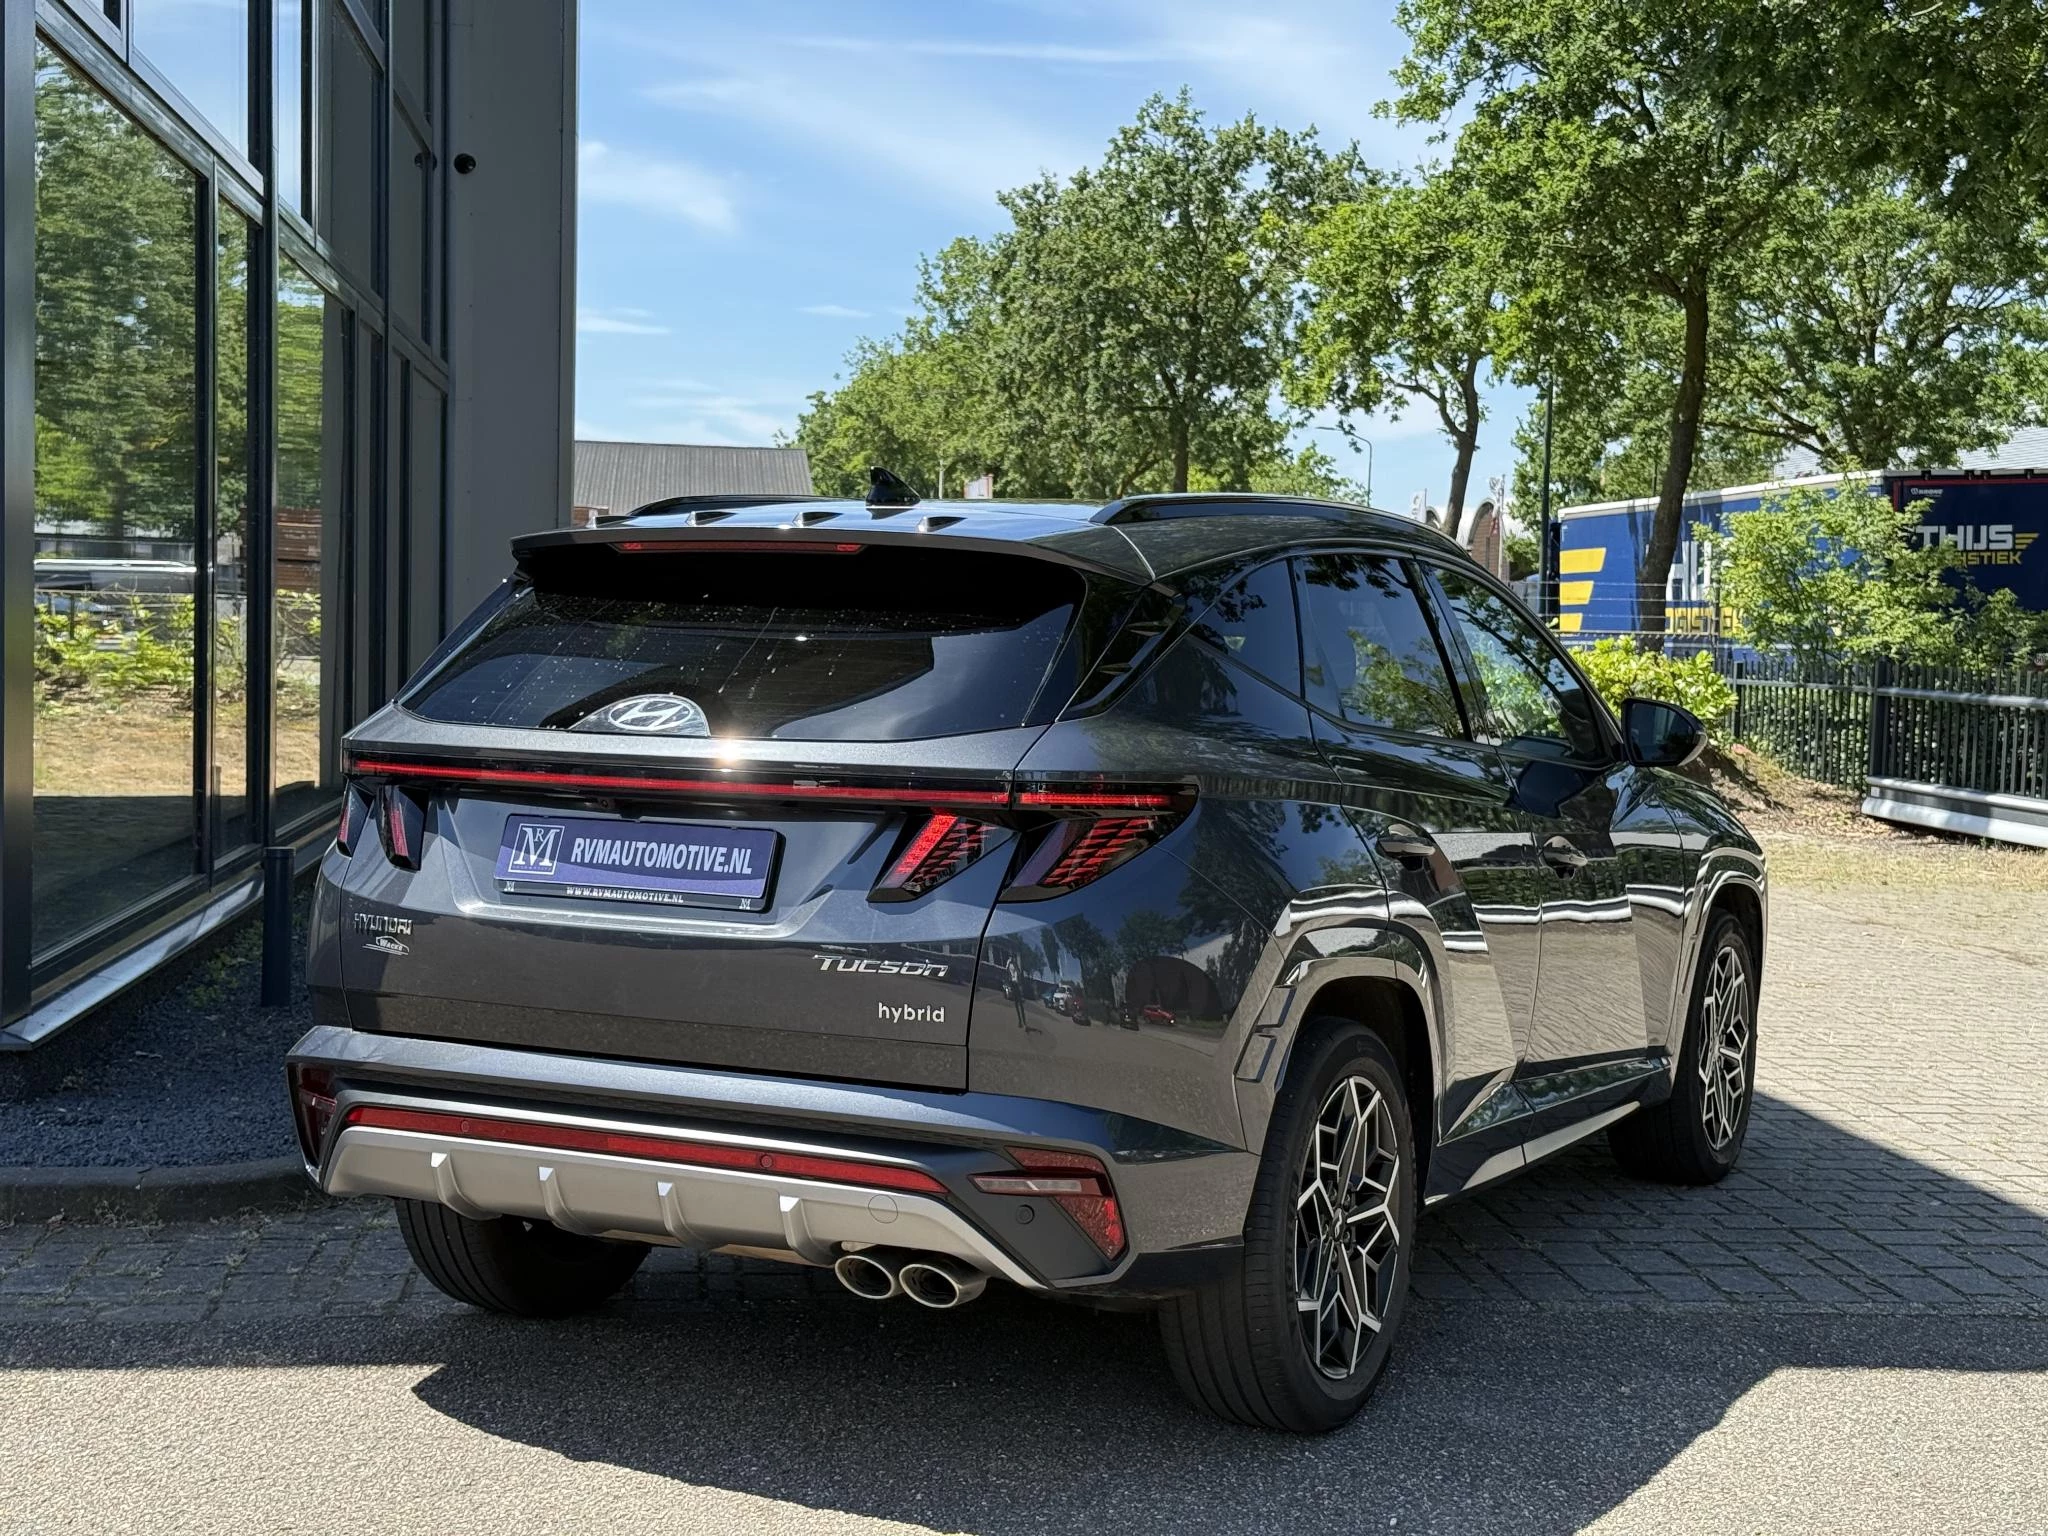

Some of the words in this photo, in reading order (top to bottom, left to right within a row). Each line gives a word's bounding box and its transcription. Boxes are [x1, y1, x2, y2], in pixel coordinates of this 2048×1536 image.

[570, 837, 753, 875] RVMAUTOMOTIVE.NL
[566, 886, 684, 904] WWW.RVMAUTOMOTIVE.NL
[353, 912, 413, 935] HYUNDAI
[812, 954, 949, 977] TUCSON
[878, 1001, 945, 1023] hybrid
